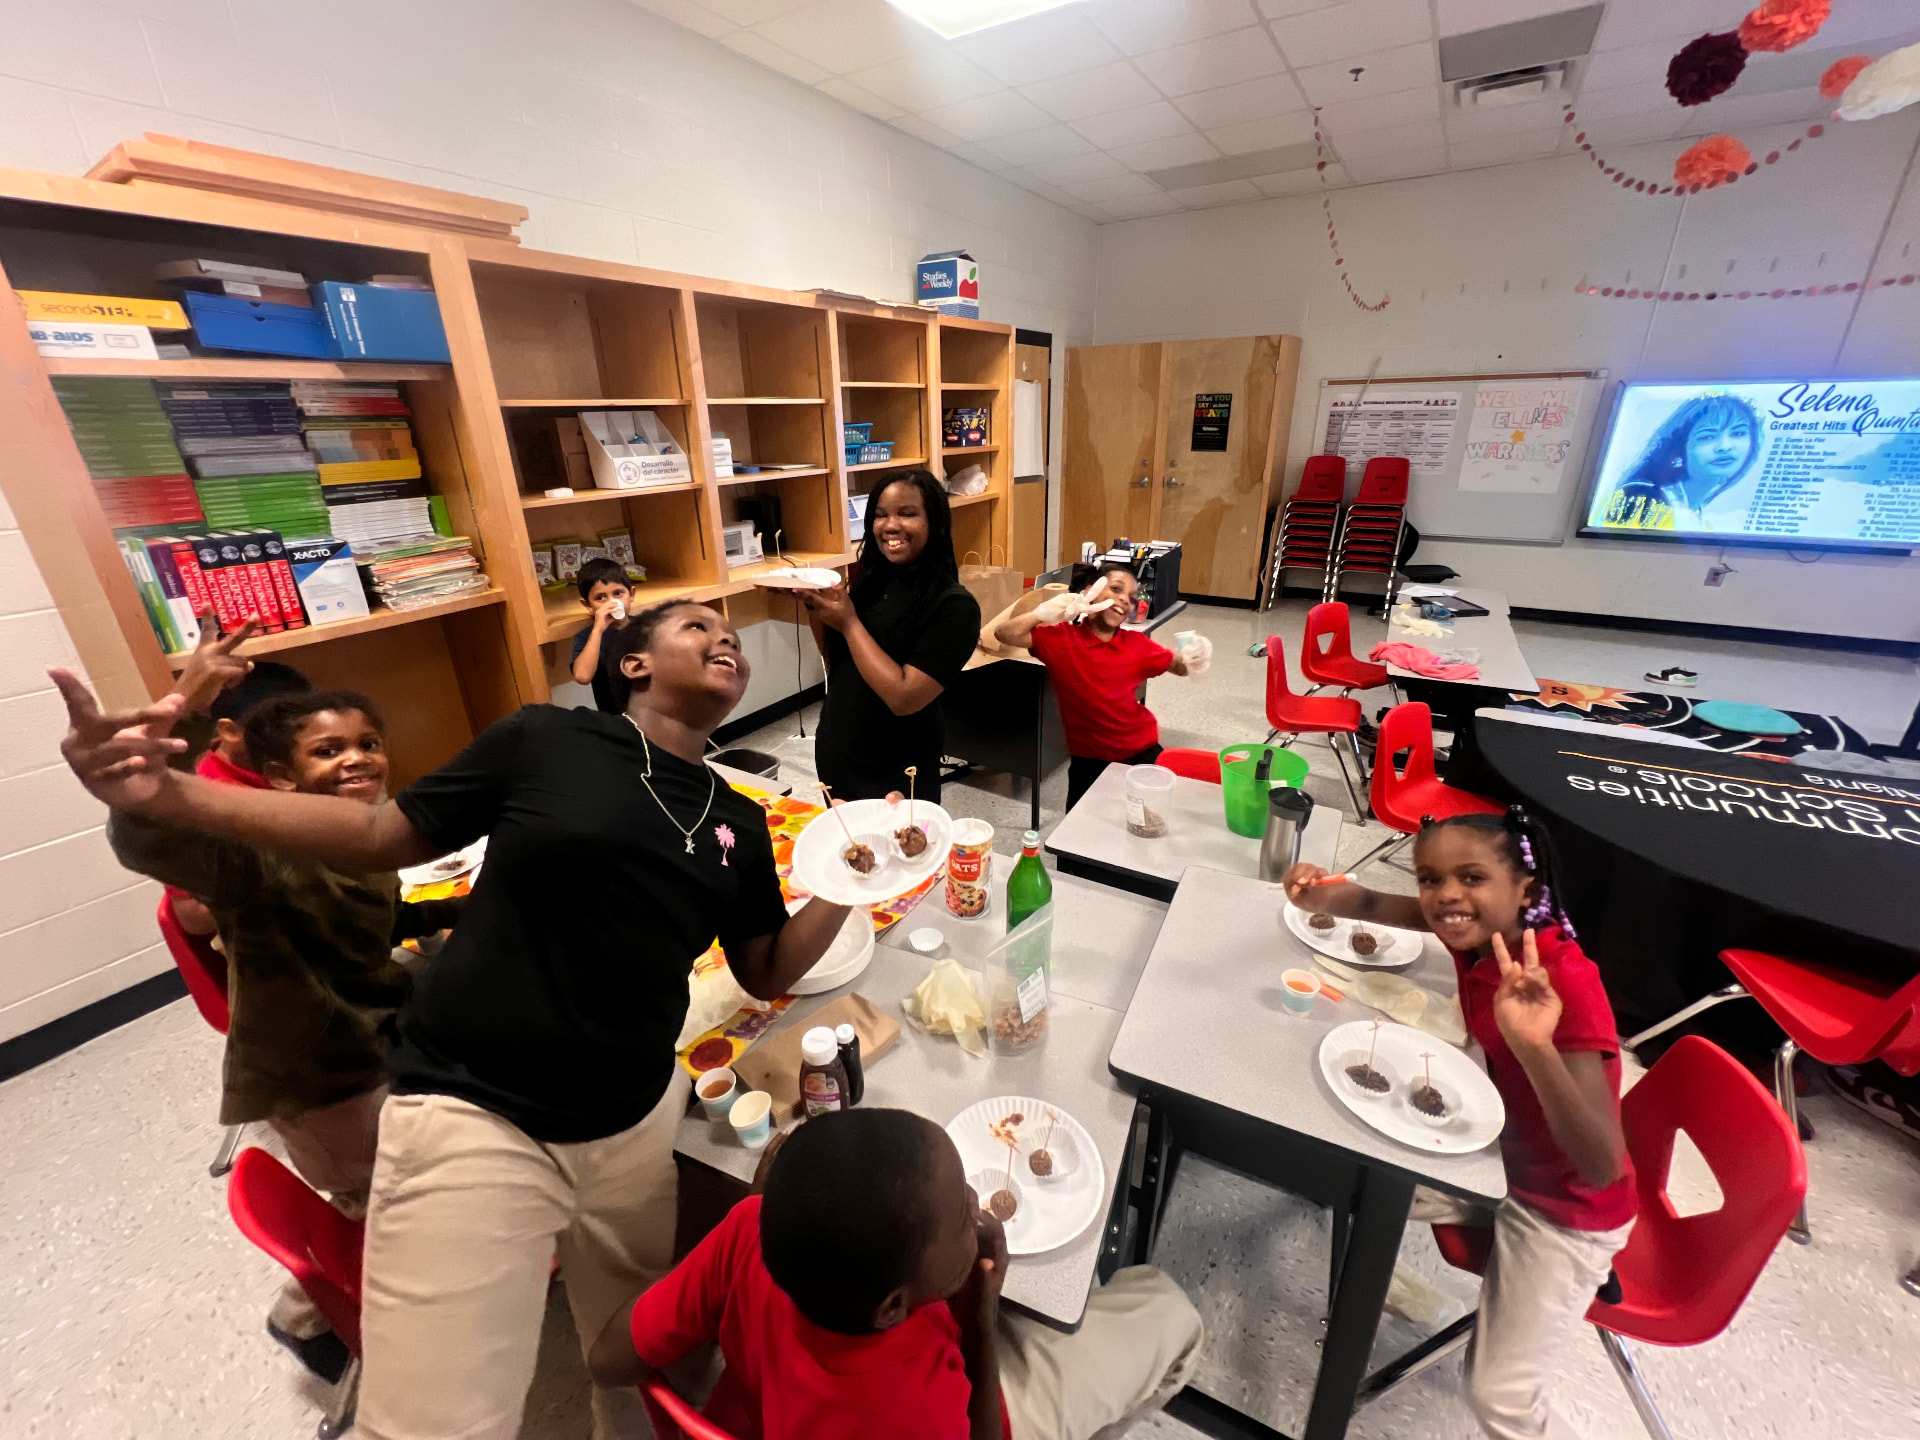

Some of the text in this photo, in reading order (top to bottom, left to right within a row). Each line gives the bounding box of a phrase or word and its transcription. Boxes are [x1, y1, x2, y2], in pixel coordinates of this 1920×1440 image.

[922, 271, 947, 281] Studies
[930, 278, 953, 288] Weekly
[1768, 383, 1877, 418] Selena
[1770, 421, 1847, 430] Greatest Hits
[204, 571, 230, 624] DICTIONARY
[226, 568, 250, 620] DICTIONARY
[248, 565, 271, 617] DICTIONARY
[269, 562, 292, 613] DICTIONARY
[1637, 770, 1887, 822] Schools
[951, 859, 978, 872] OATS
